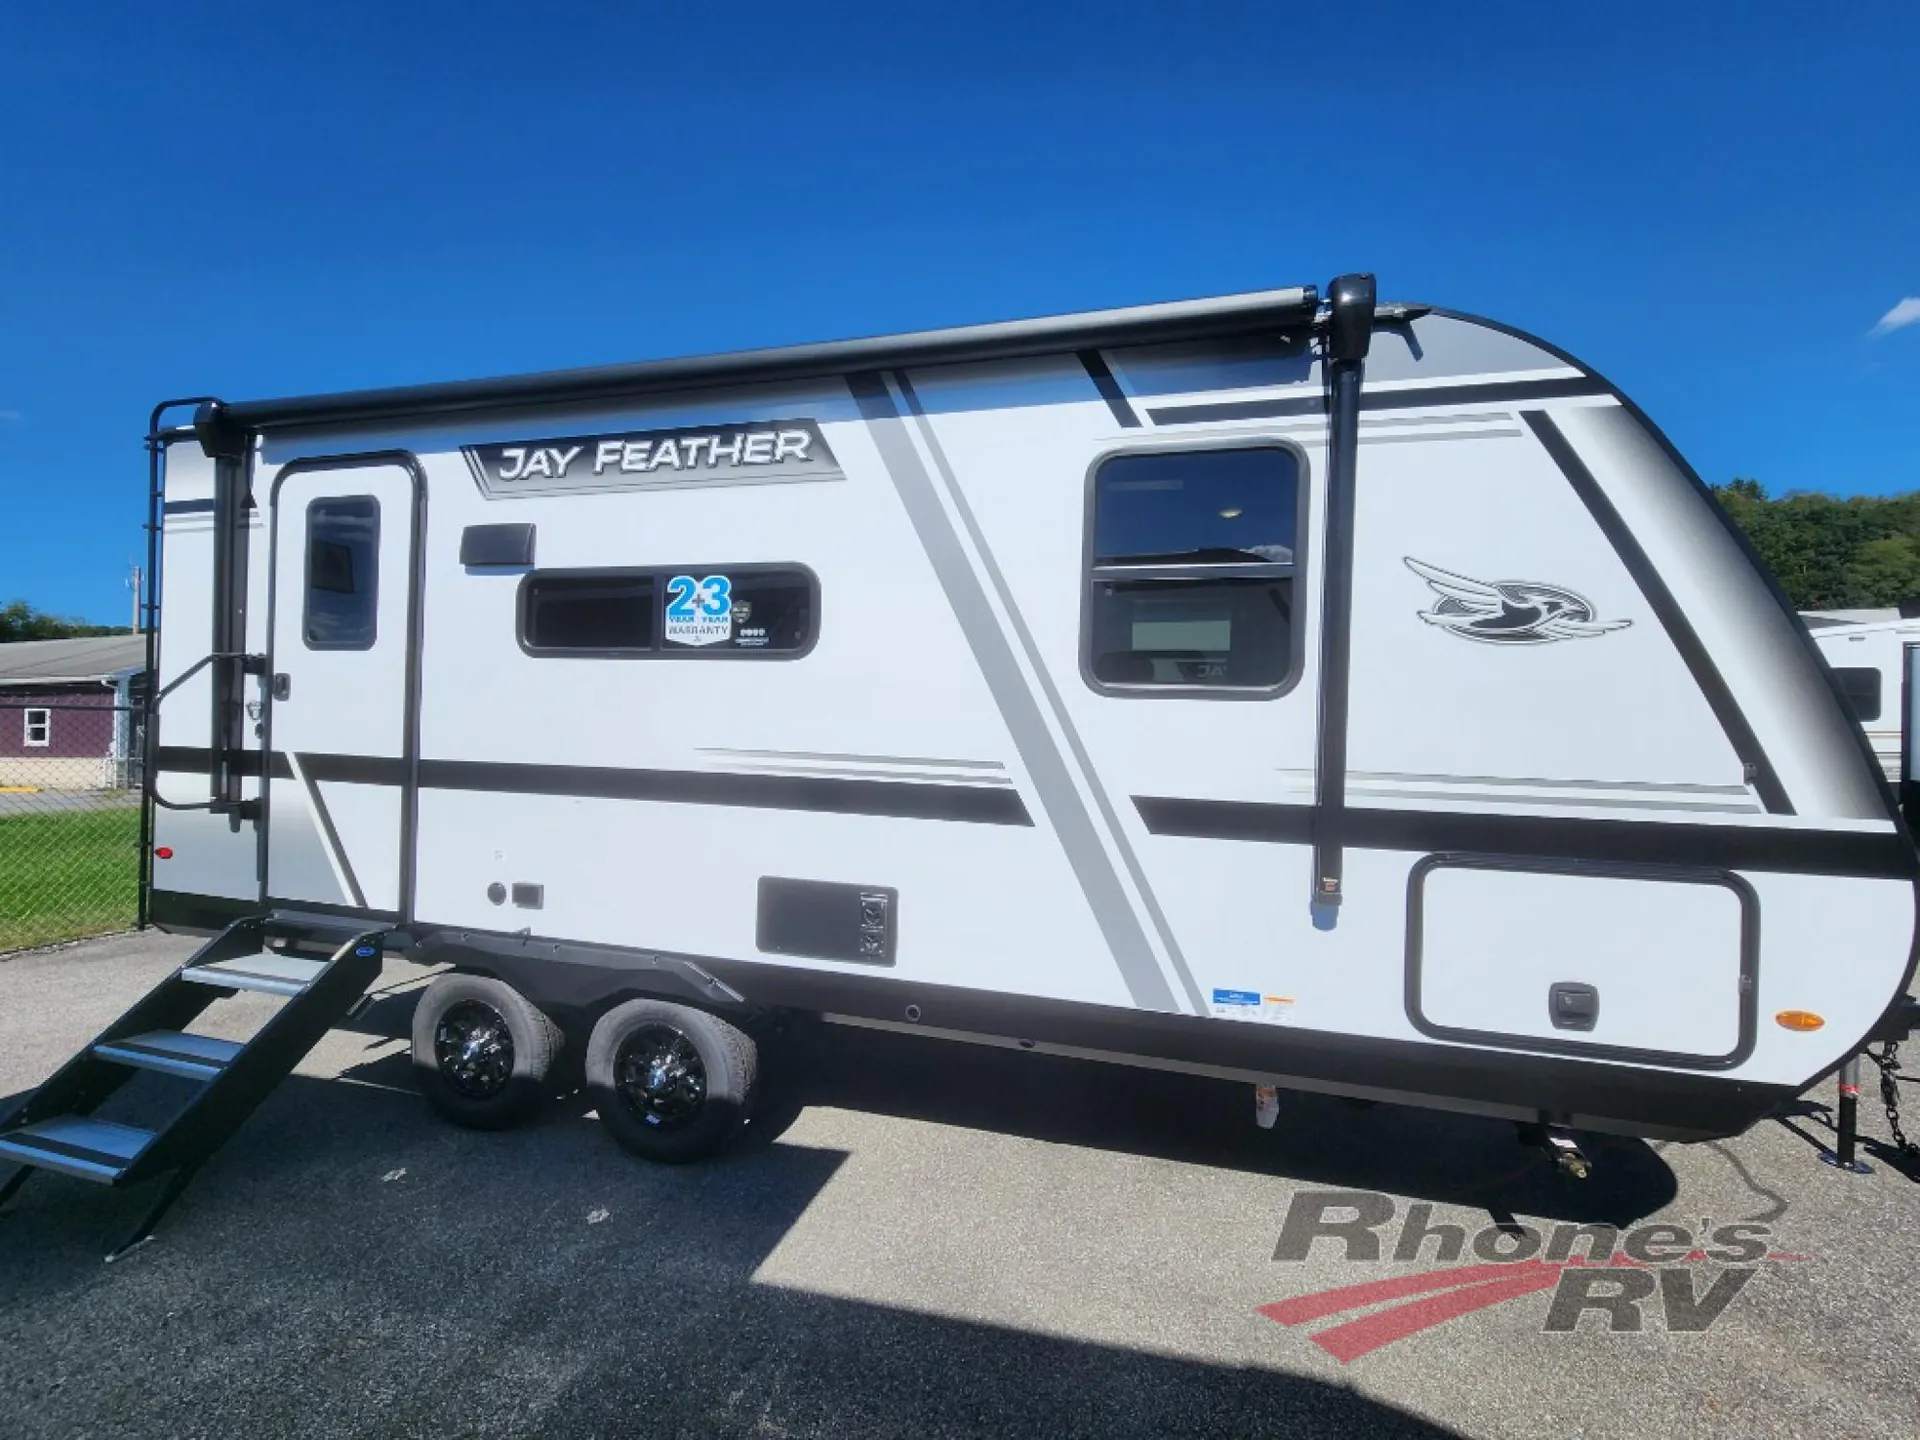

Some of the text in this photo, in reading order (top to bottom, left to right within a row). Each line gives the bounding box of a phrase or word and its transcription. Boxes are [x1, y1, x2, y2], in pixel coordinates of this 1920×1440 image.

[499, 429, 813, 481] JAY FEATHER
[668, 626, 729, 635] WARRANTY
